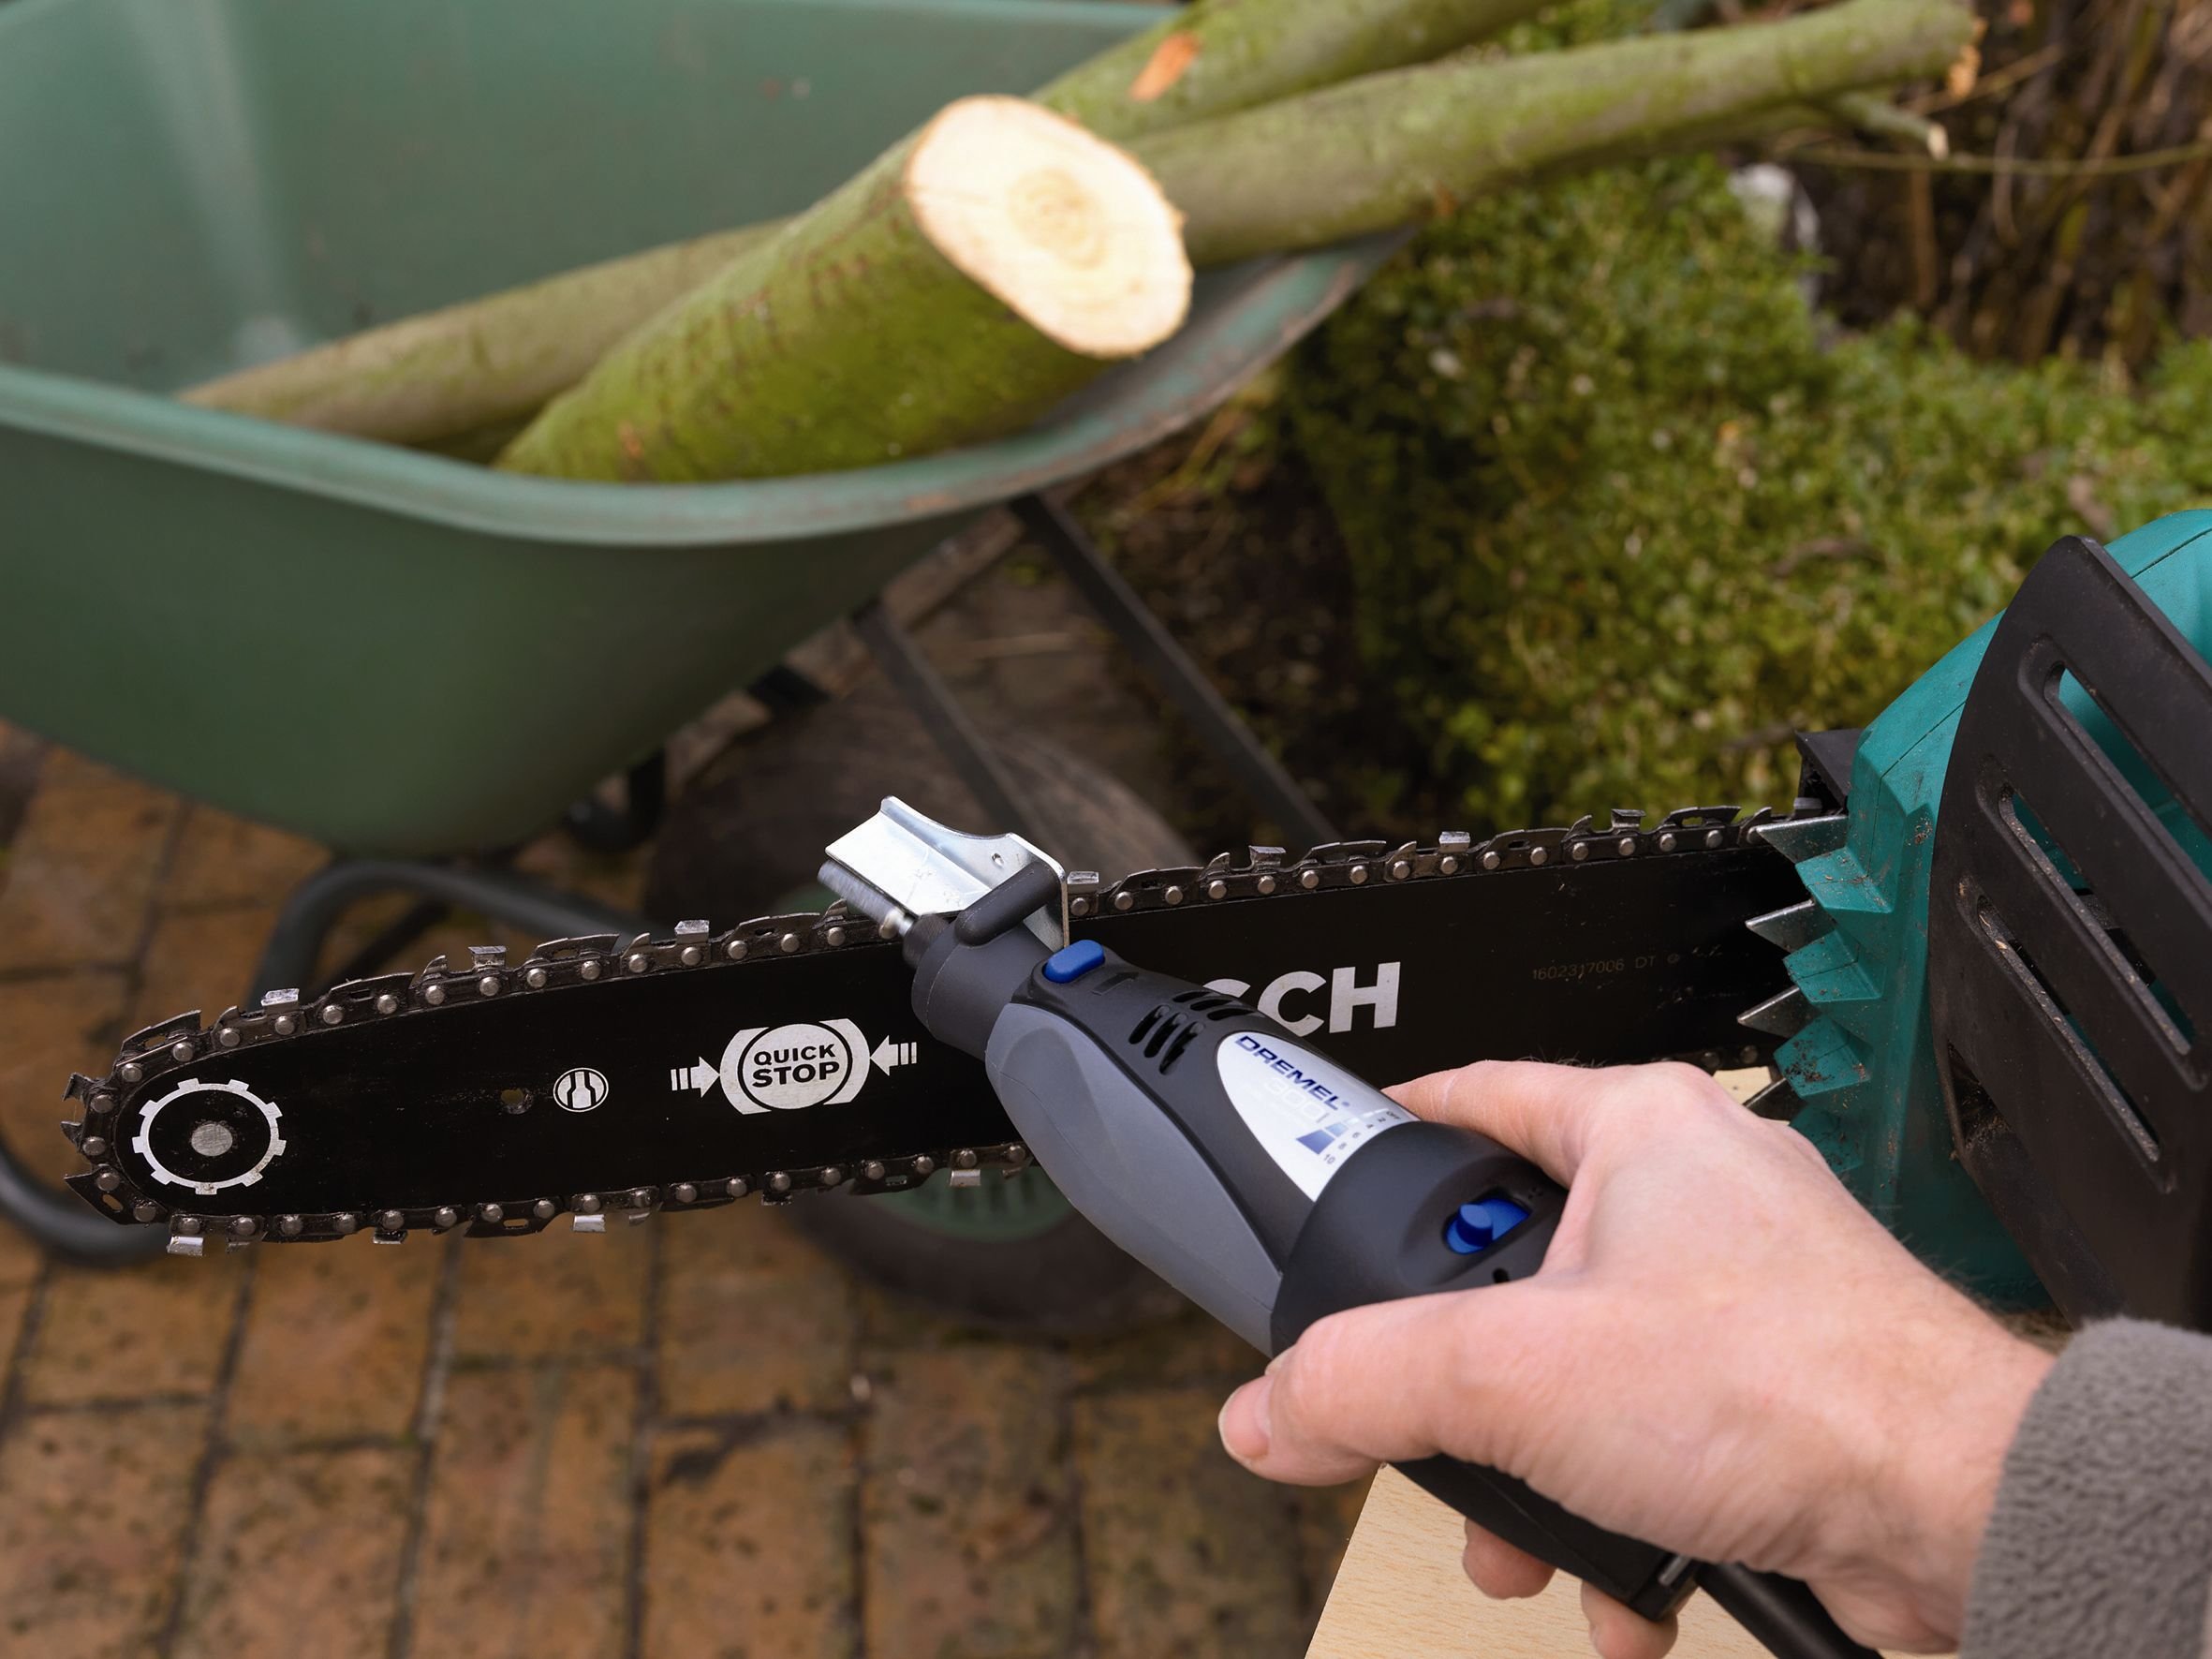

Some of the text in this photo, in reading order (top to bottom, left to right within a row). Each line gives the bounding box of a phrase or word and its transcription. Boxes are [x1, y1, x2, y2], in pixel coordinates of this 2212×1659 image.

[1202, 961, 1401, 1037] CH
[754, 1044, 836, 1065] QUICK
[752, 1061, 840, 1088] STOP
[1235, 1035, 1340, 1111] DREMEL
[1323, 1153, 1335, 1164] 10
